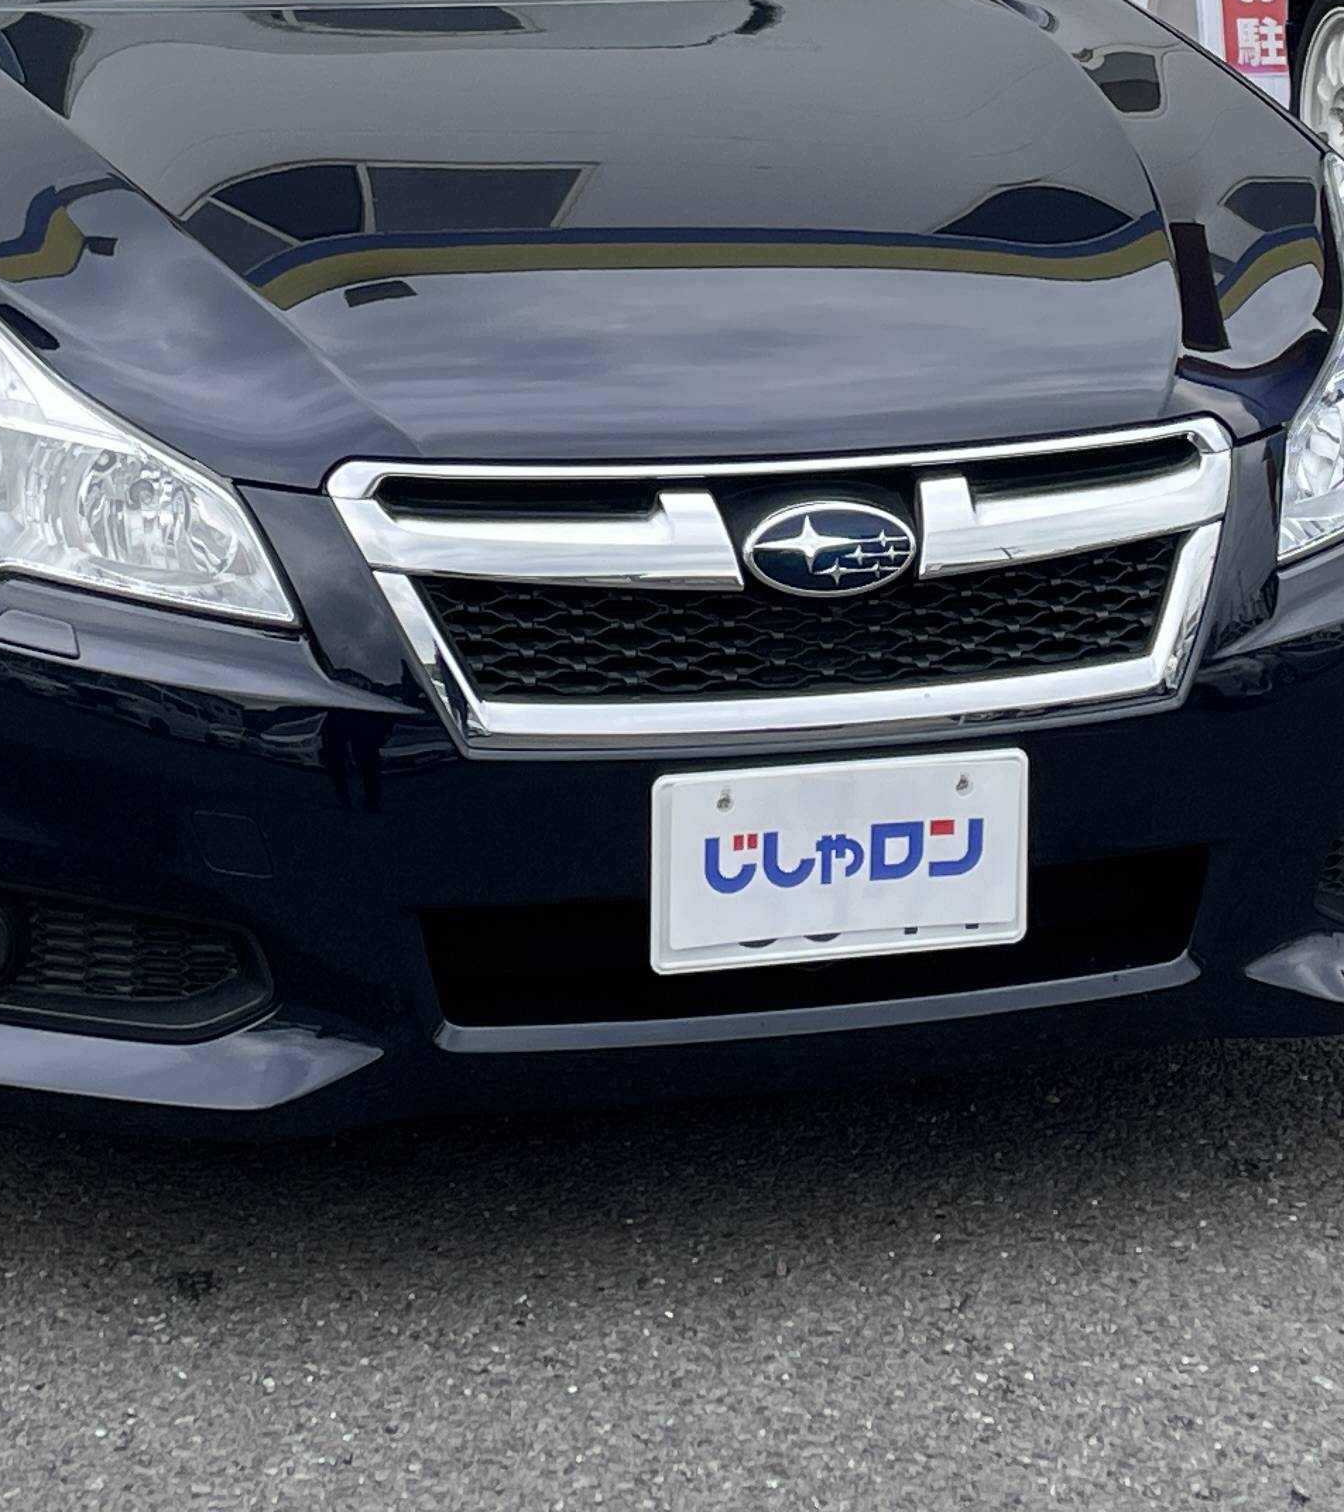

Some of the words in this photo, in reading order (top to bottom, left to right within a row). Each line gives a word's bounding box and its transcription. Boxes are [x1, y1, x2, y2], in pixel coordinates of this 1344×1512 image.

[704, 818, 984, 894] じしゃロン
